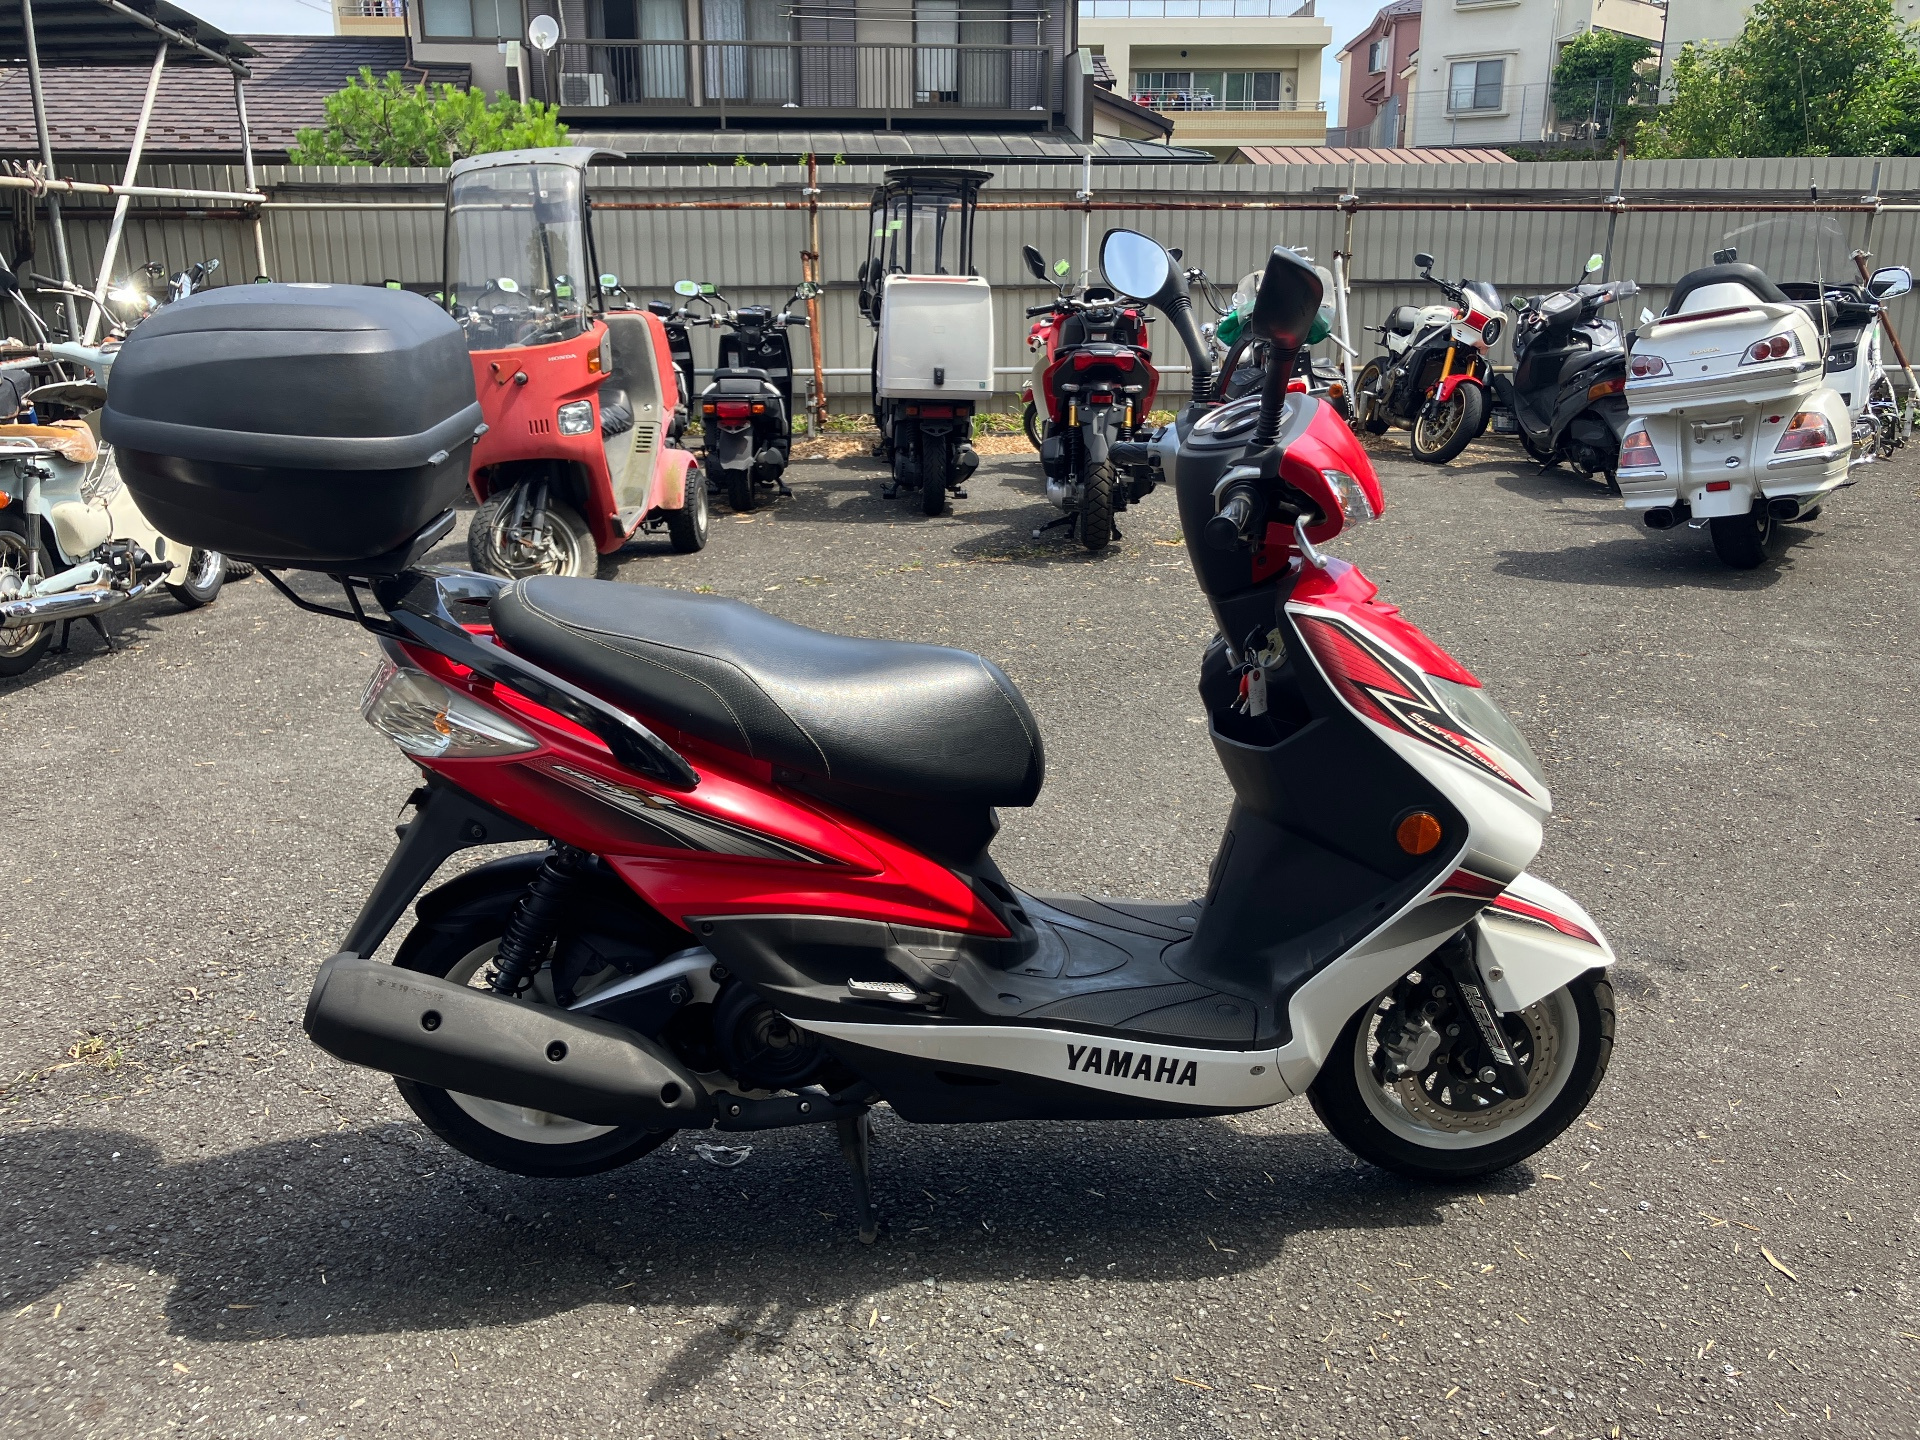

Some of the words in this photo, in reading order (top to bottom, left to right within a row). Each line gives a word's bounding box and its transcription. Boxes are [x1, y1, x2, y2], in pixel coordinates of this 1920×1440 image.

[547, 353, 577, 362] HONDA
[1407, 711, 1461, 746] Sports
[1460, 744, 1512, 781] Scooter
[1066, 1043, 1198, 1087] YAMAHA
